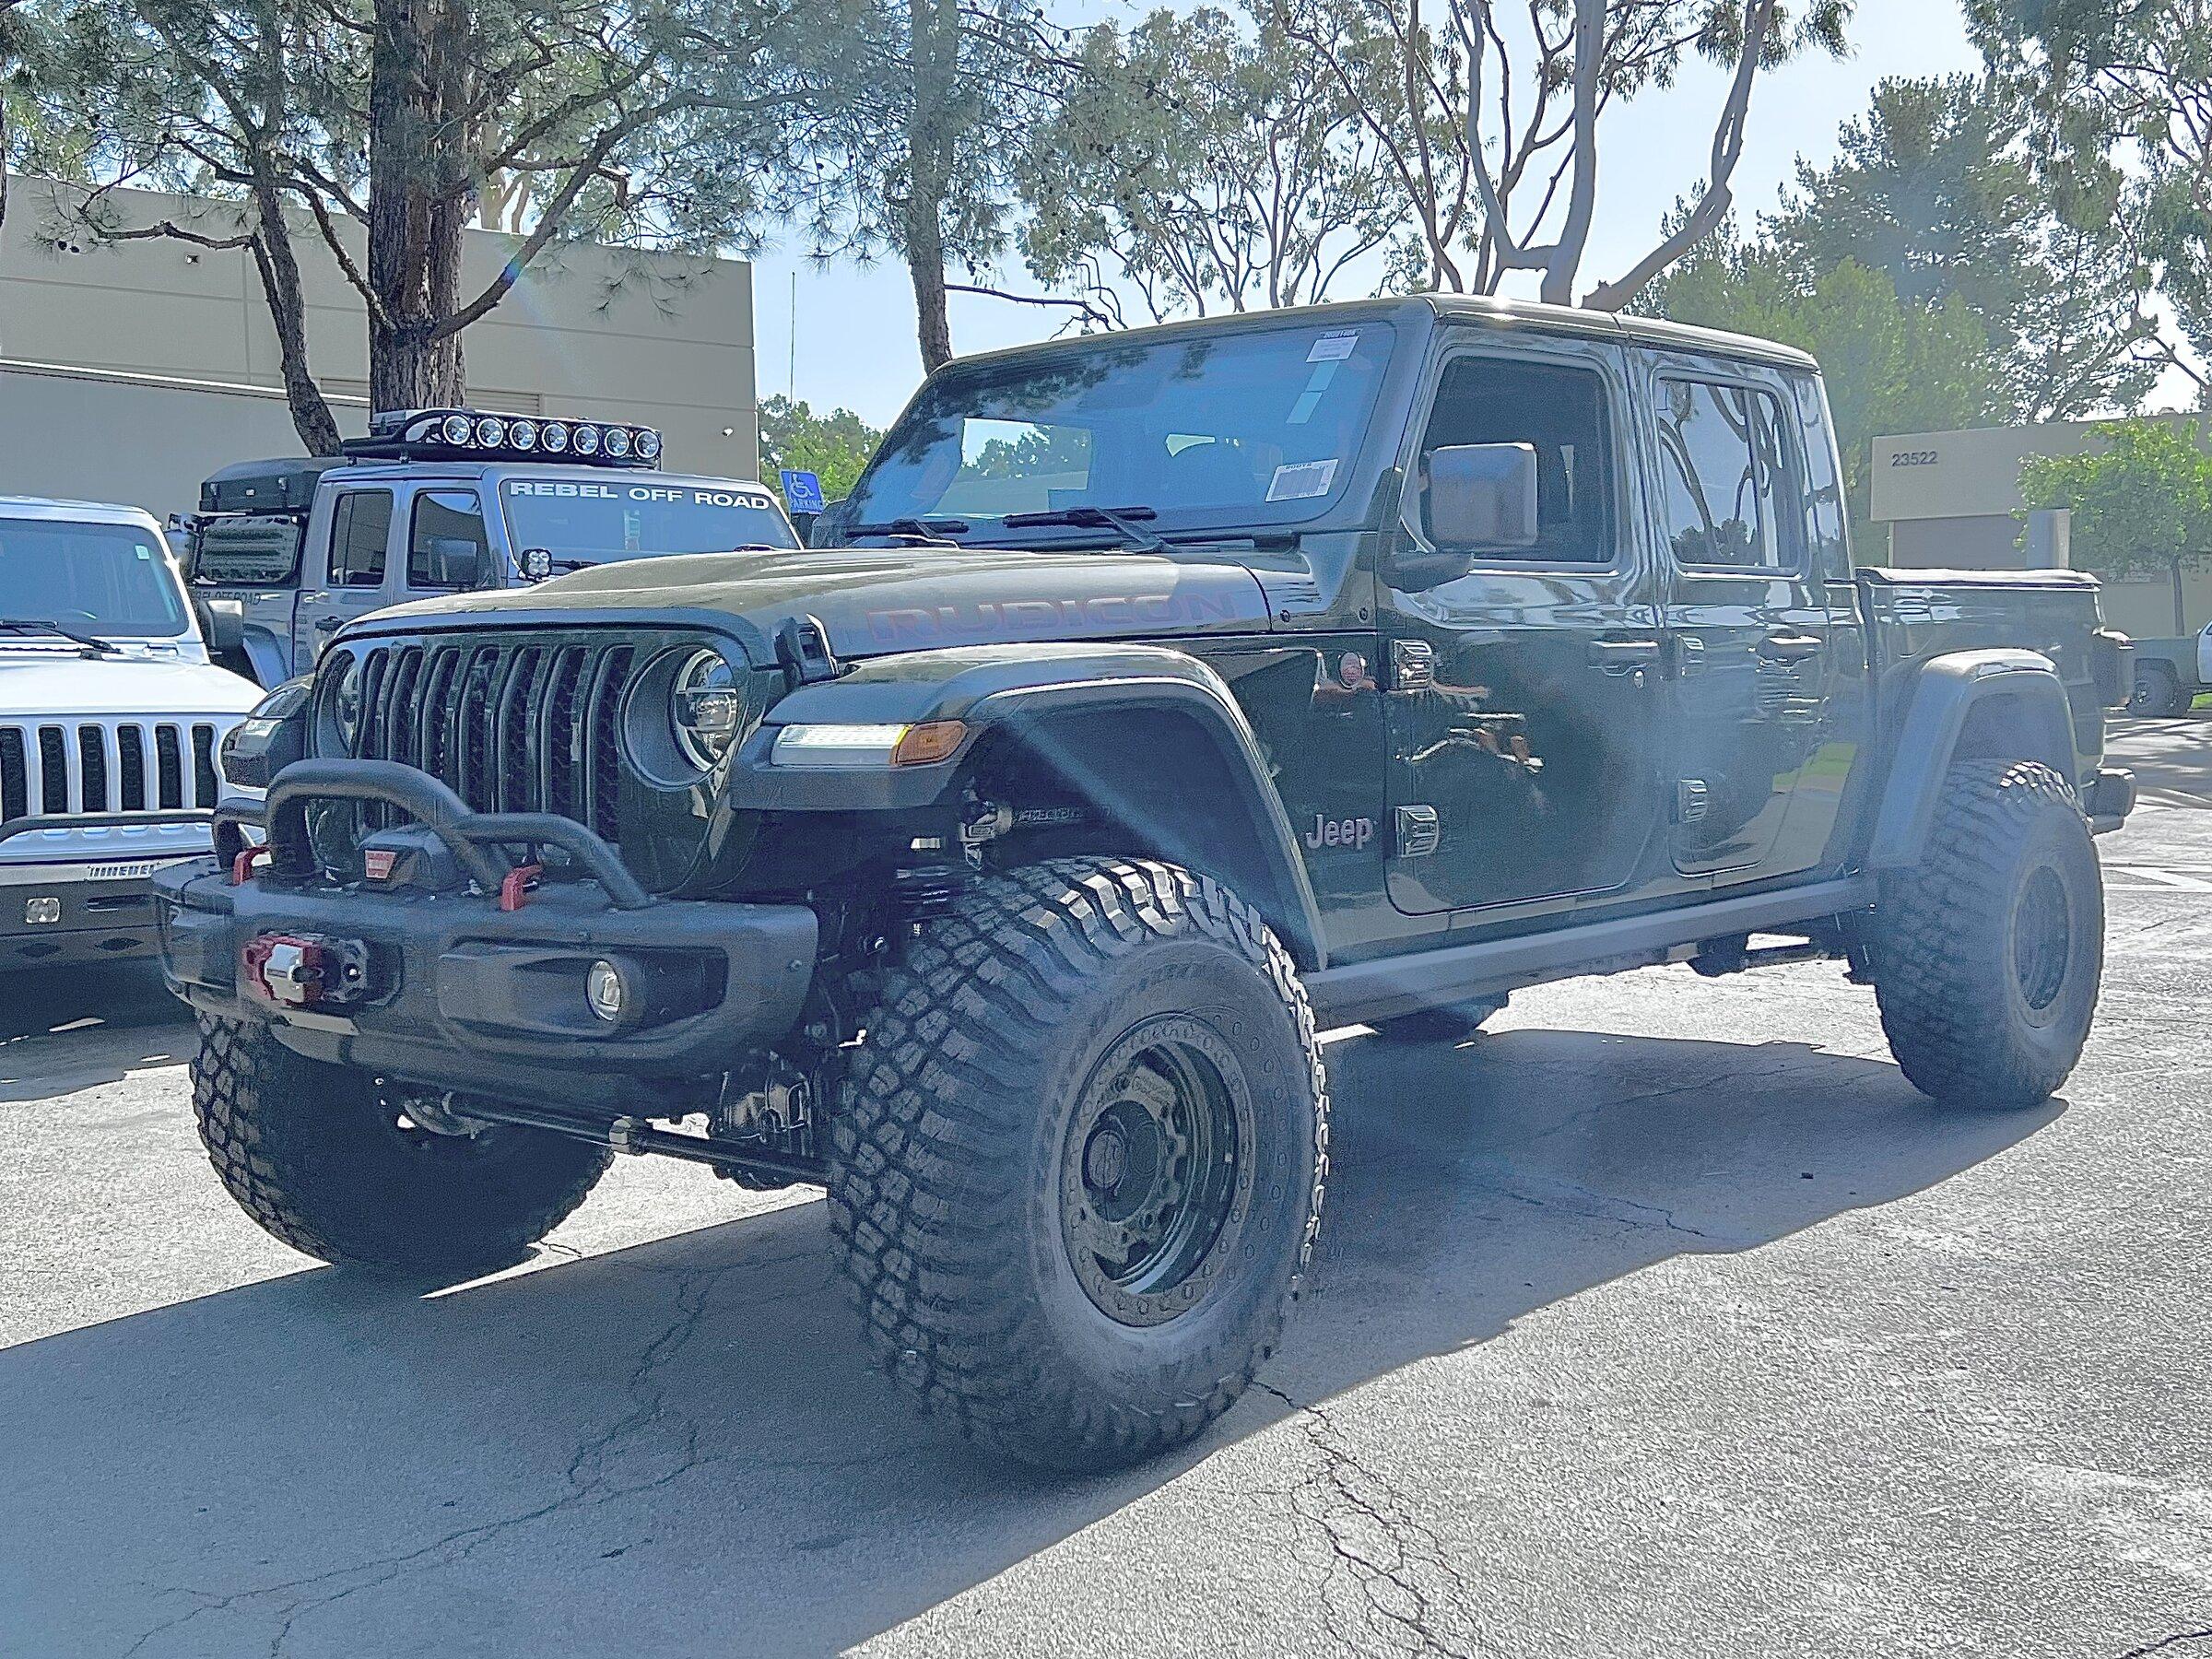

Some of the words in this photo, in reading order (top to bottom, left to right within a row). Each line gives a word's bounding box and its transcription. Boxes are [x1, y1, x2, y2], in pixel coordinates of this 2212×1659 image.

[1891, 451, 1938, 467] 23522
[510, 481, 618, 499] REBEL
[628, 487, 683, 502] OFF
[694, 491, 770, 510] ROAD
[867, 591, 1238, 642] RUBICON
[1306, 814, 1373, 850] Jeep
